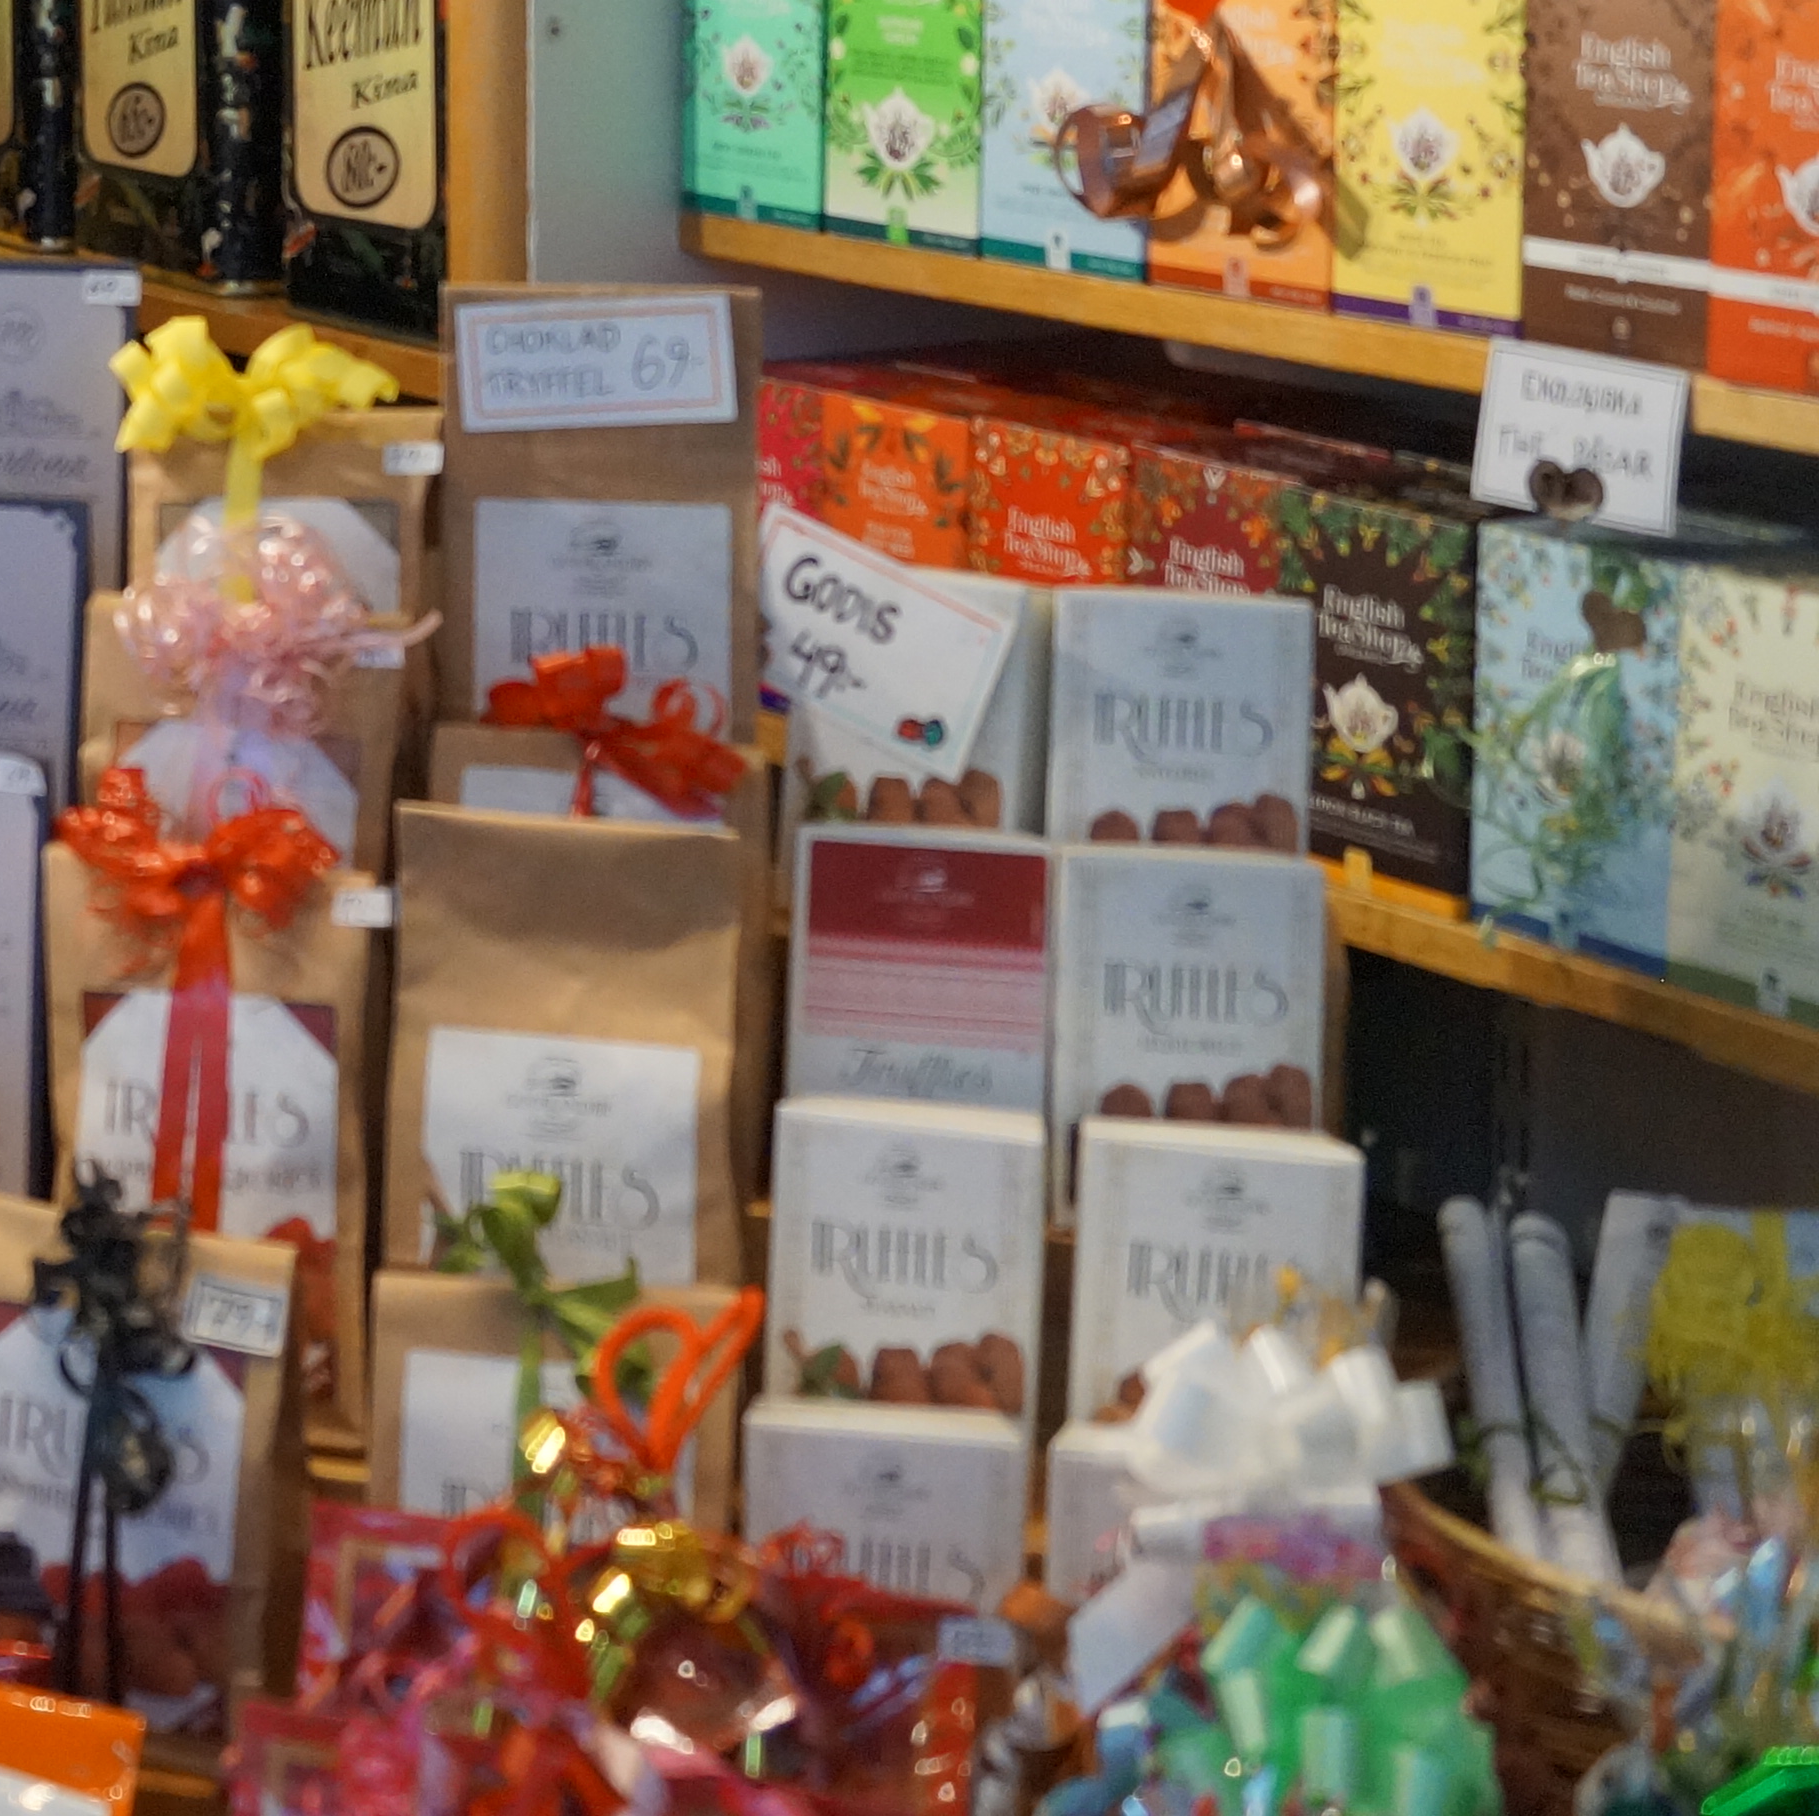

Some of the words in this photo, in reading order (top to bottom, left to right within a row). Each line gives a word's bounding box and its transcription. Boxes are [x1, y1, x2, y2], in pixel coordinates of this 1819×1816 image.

[351, 70, 418, 110] Kina
[781, 551, 903, 648] GODIS
[1322, 584, 1406, 630] English
